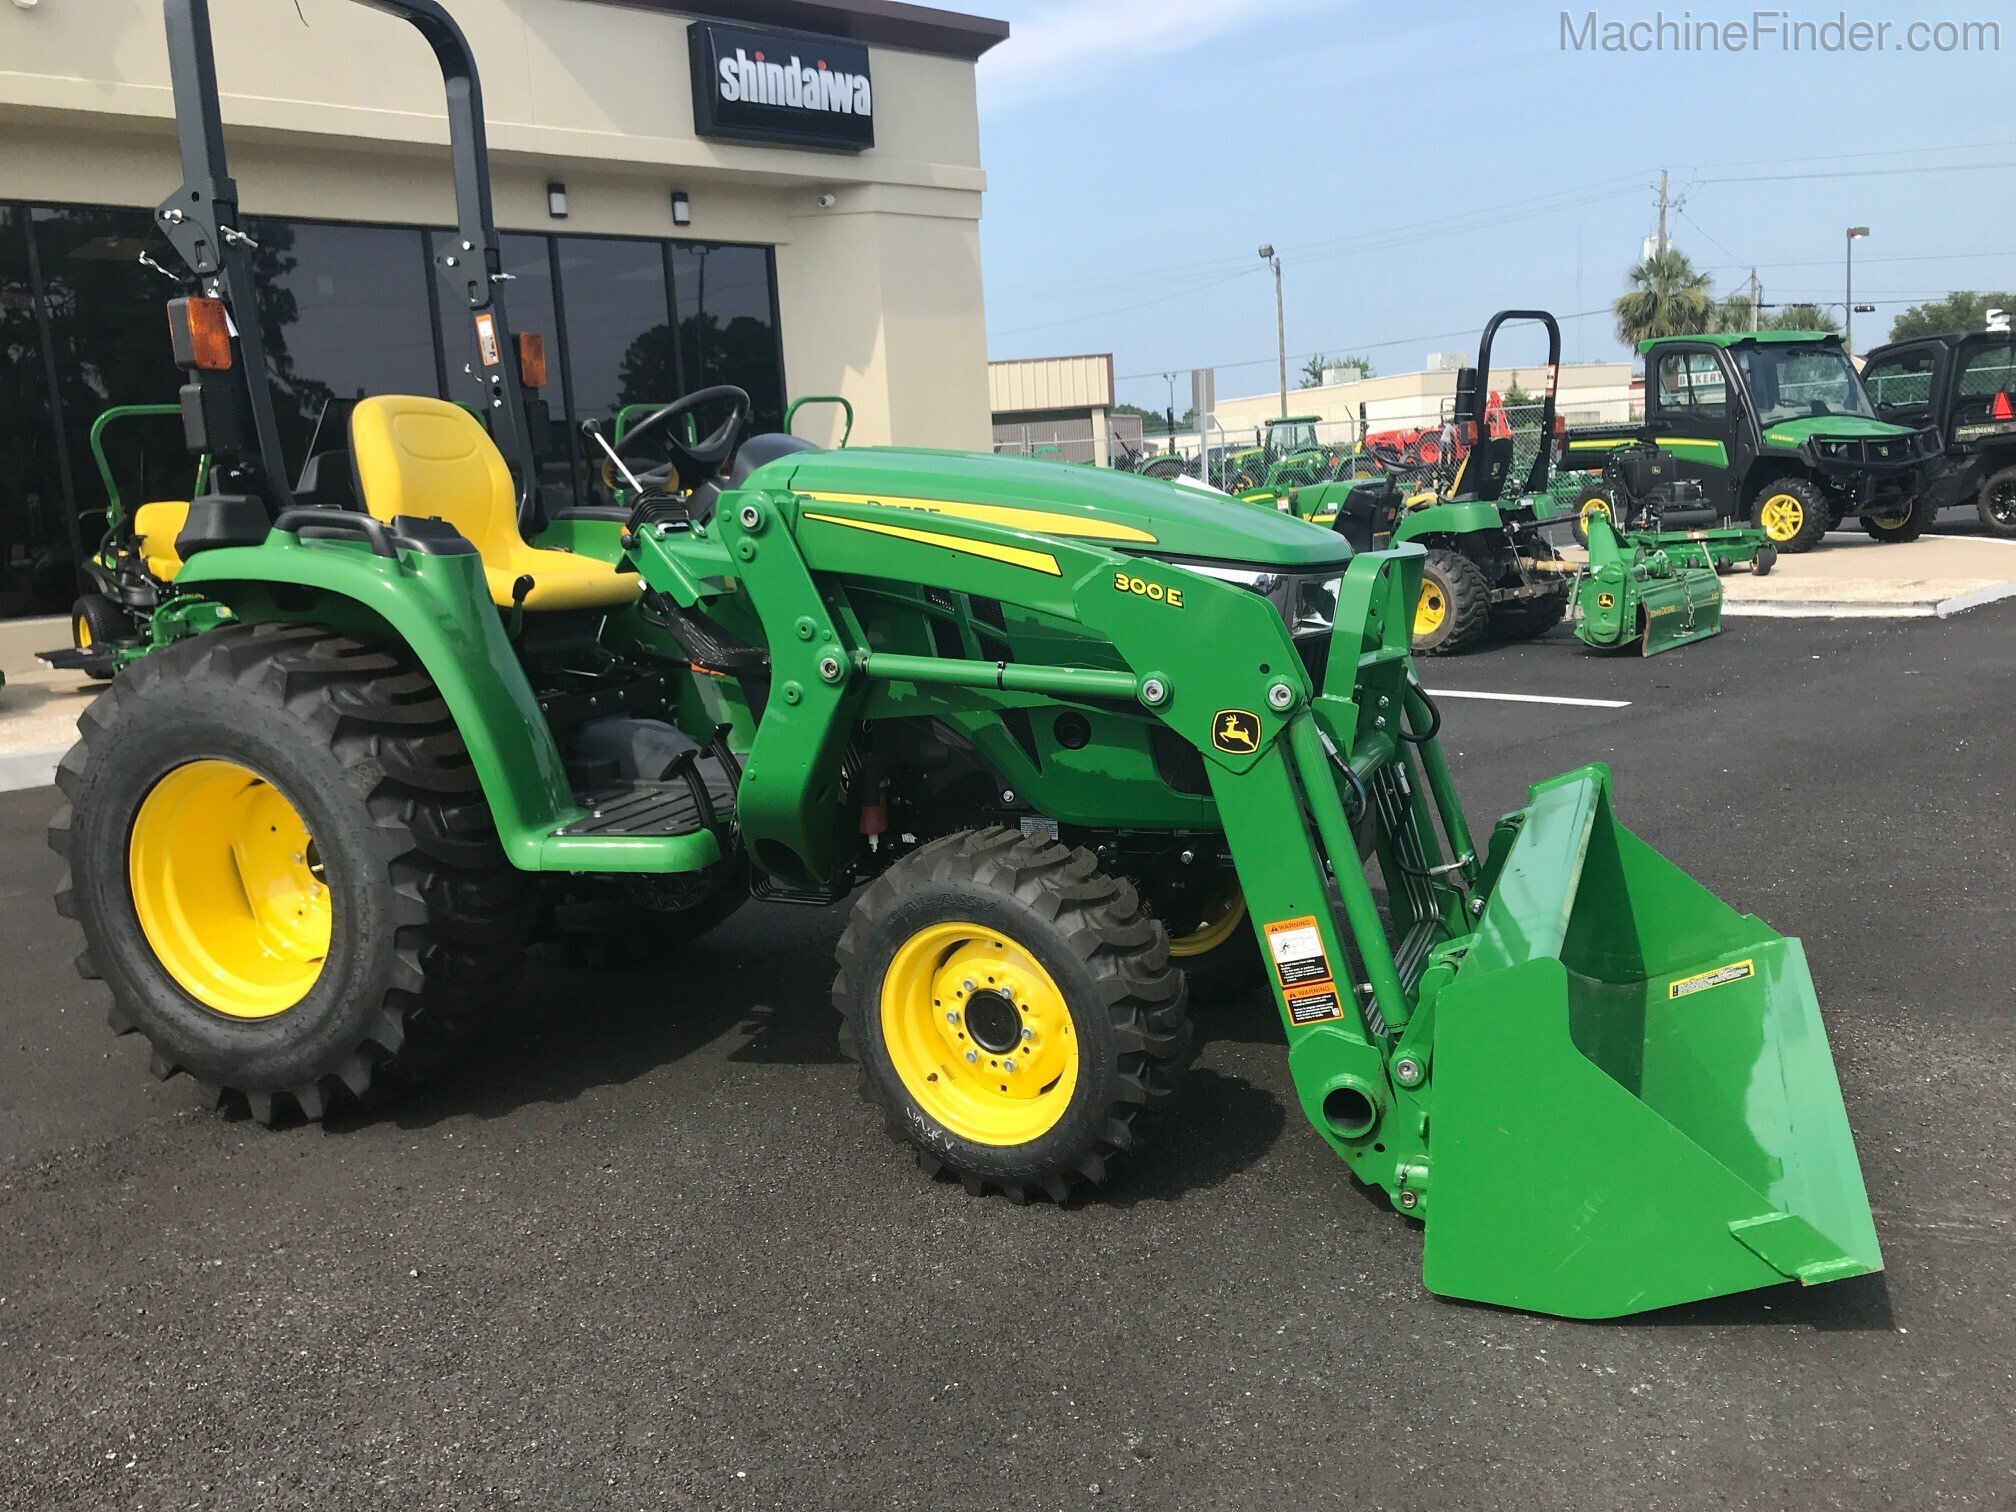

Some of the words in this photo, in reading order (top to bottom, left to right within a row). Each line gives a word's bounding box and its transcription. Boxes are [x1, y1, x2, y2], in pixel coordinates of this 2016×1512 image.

[718, 47, 872, 117] shindaiwa
[1679, 372, 1723, 385] BKERY
[1279, 920, 1311, 931] WARNING
[1298, 985, 1331, 996] WARNING
